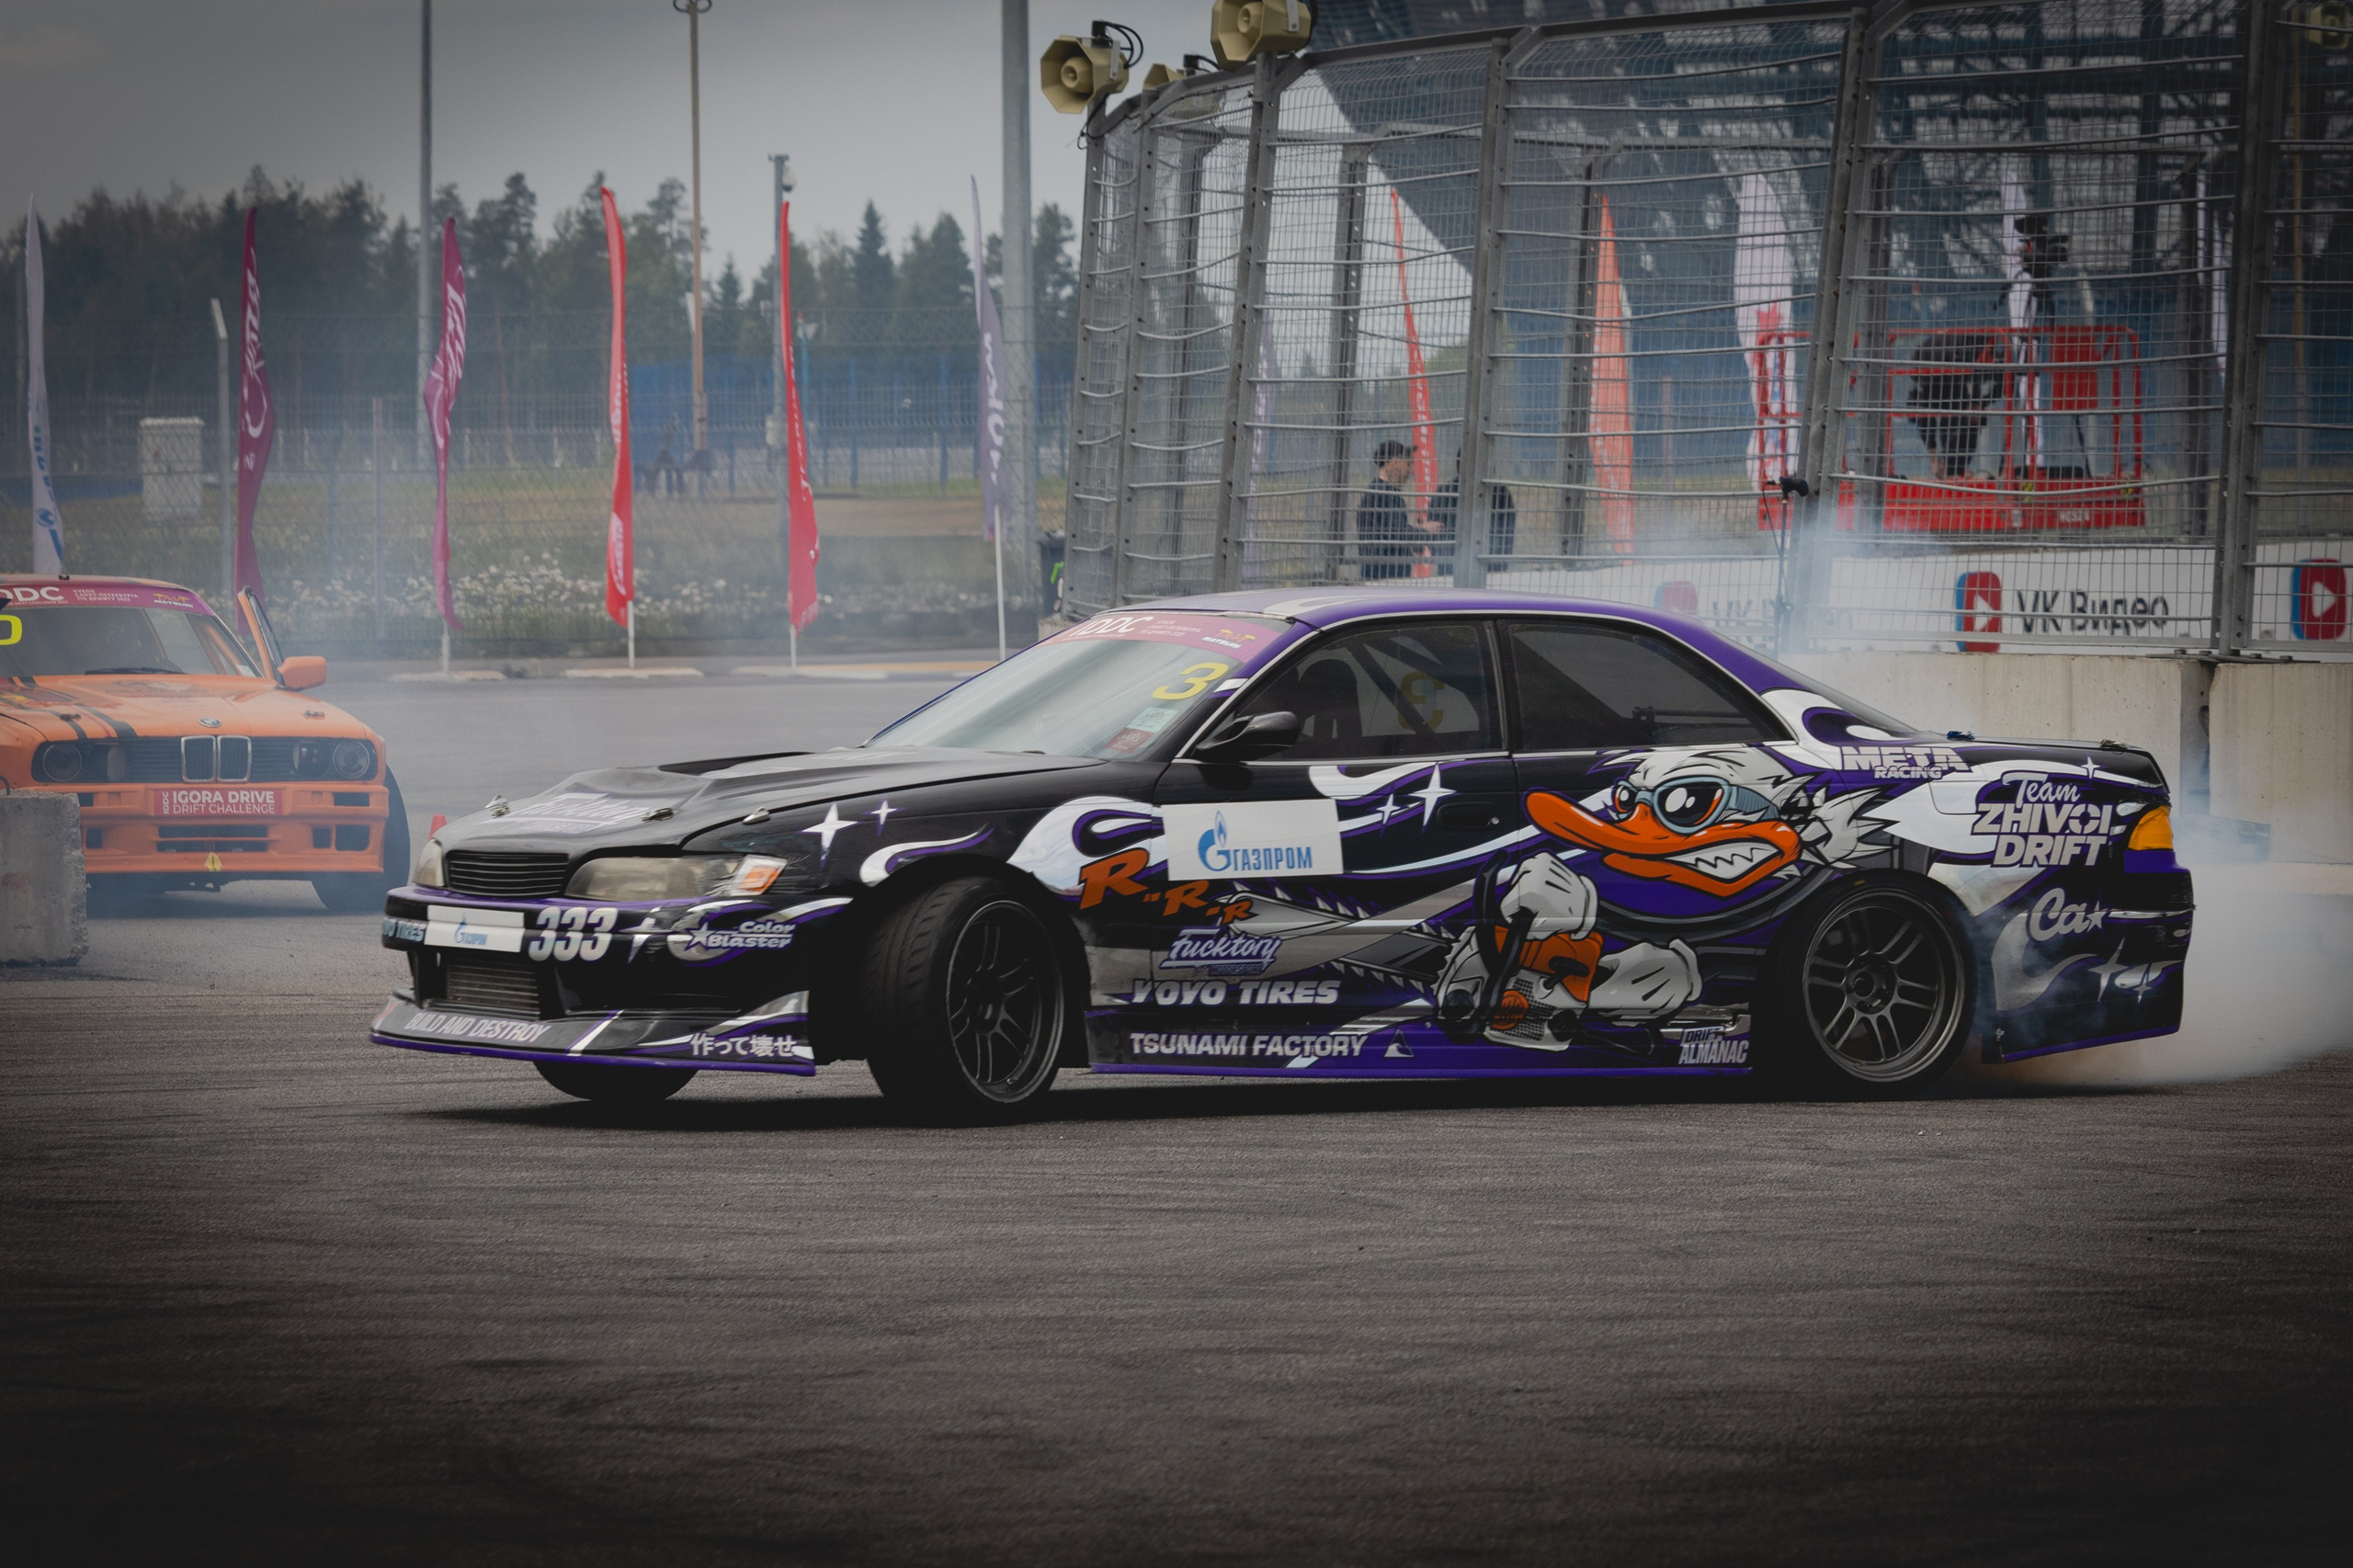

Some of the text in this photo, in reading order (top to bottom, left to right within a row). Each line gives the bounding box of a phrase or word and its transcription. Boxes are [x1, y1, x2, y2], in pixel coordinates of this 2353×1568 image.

[2016, 590, 2169, 636] VK Видео
[1152, 663, 1230, 700] 3
[1841, 745, 1971, 772] META
[1873, 765, 1943, 779] RACING
[173, 790, 275, 803] IGORA DRIVE
[2002, 772, 2080, 808] Team
[173, 803, 275, 814] DRIFT CHALLENGE
[1972, 802, 2113, 835] ZHIVOI
[1233, 846, 1313, 872] ГАЗПРОМ
[1992, 835, 2108, 867] DRIFT
[529, 906, 618, 961] 333
[738, 921, 796, 934] Color
[707, 934, 792, 949] Blaster
[1168, 928, 1283, 966] Fucktory
[1131, 980, 1341, 1006] YOYO TIRES
[404, 1012, 551, 1042] BUILD AND DESTROY
[690, 1032, 797, 1057] 作って壊せ
[1130, 1032, 1369, 1057] TSUNAMI FACTORY
[1678, 1040, 1750, 1064] ALMANAC
